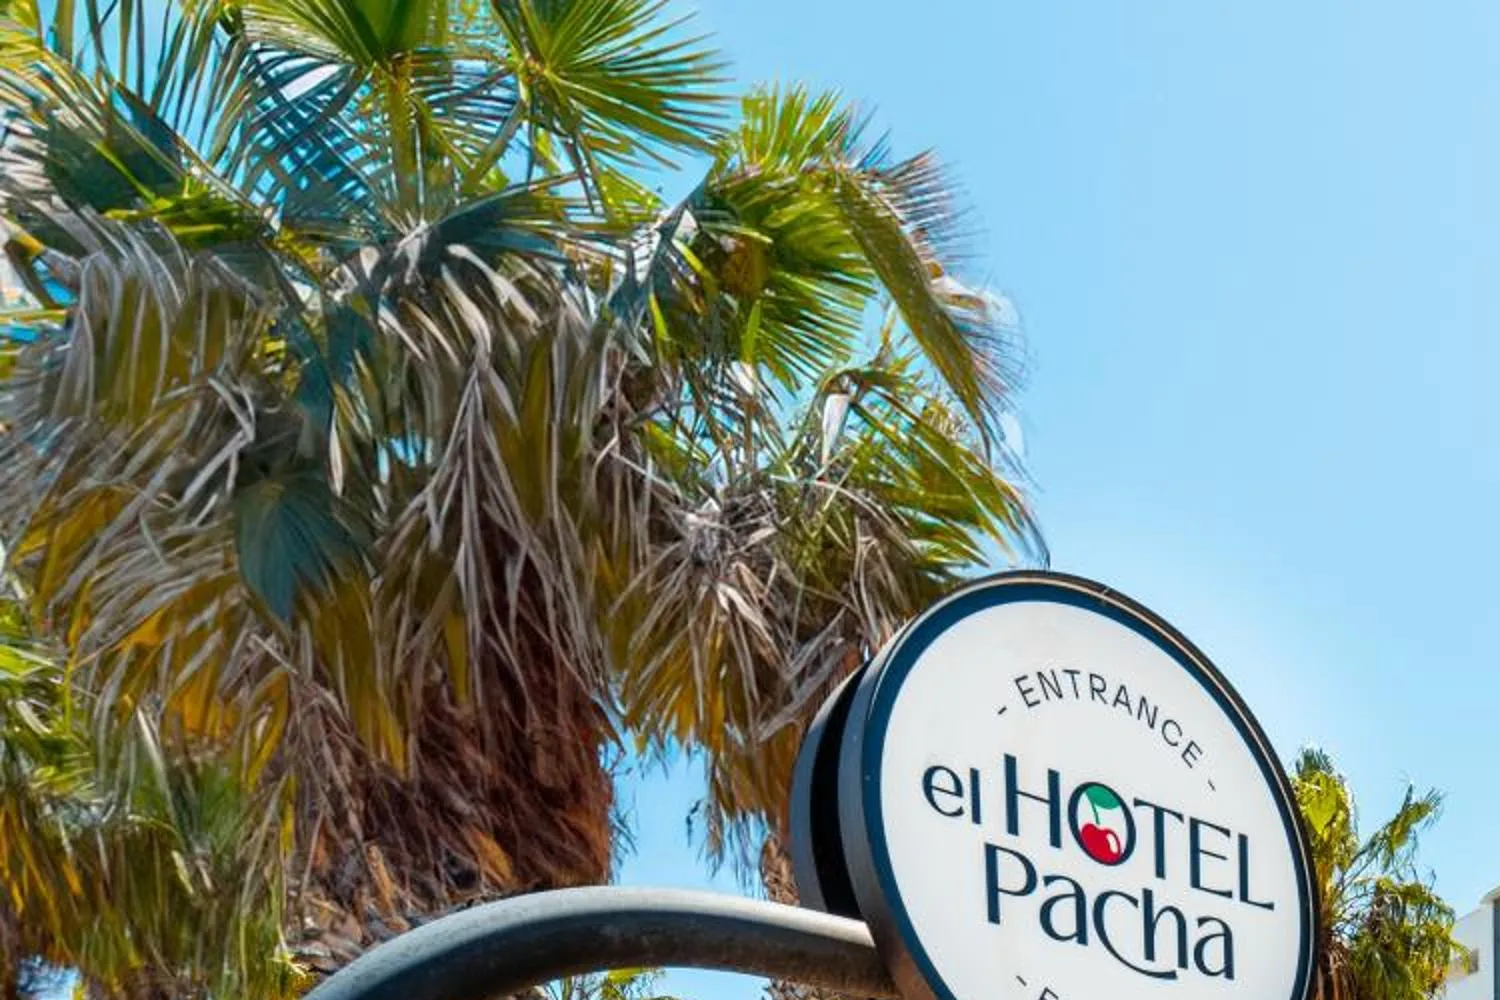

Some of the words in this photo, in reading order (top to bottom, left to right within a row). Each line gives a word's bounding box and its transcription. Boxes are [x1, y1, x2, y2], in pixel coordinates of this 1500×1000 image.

[1014, 668, 1203, 769] ENTRANCE
[921, 765, 982, 825] el
[1003, 753, 1275, 911] HOTEL
[983, 843, 1236, 981] Pacha
